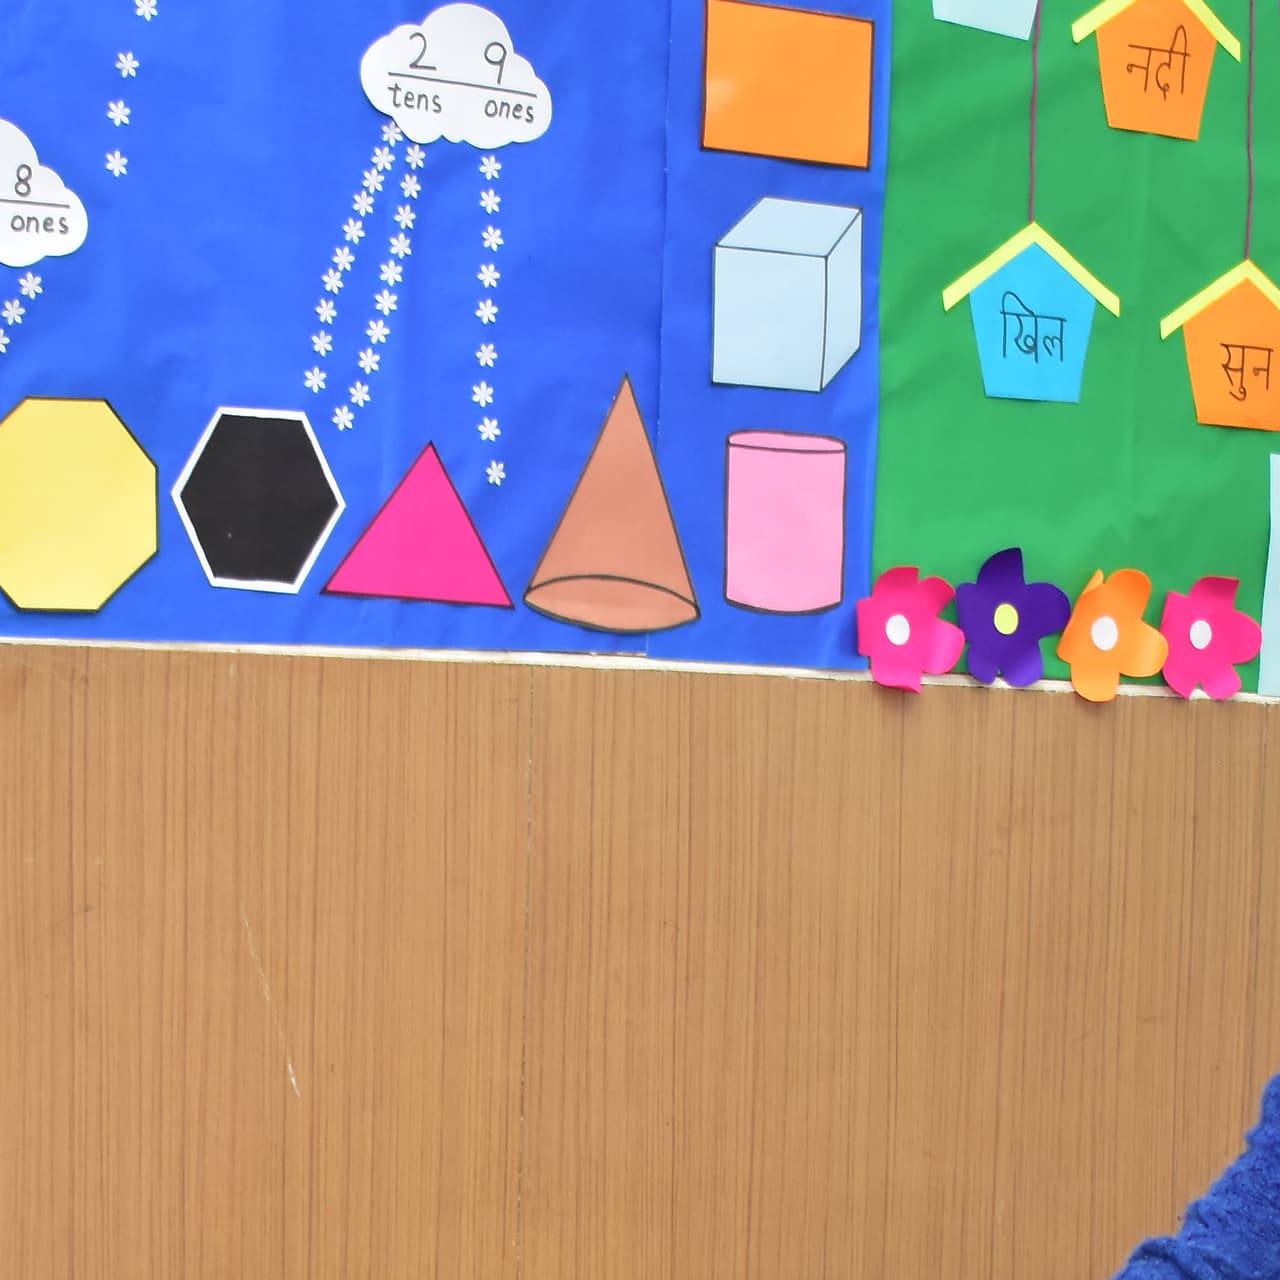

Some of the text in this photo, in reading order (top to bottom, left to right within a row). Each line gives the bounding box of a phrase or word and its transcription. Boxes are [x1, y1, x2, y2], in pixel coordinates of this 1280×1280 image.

[410, 33, 507, 84] 2 9
[1126, 24, 1190, 101] नदी
[388, 83, 535, 124] tens ones
[14, 165, 32, 196] 8
[10, 211, 69, 235] ones
[999, 291, 1067, 363] खिल
[1220, 342, 1273, 400] सुन
